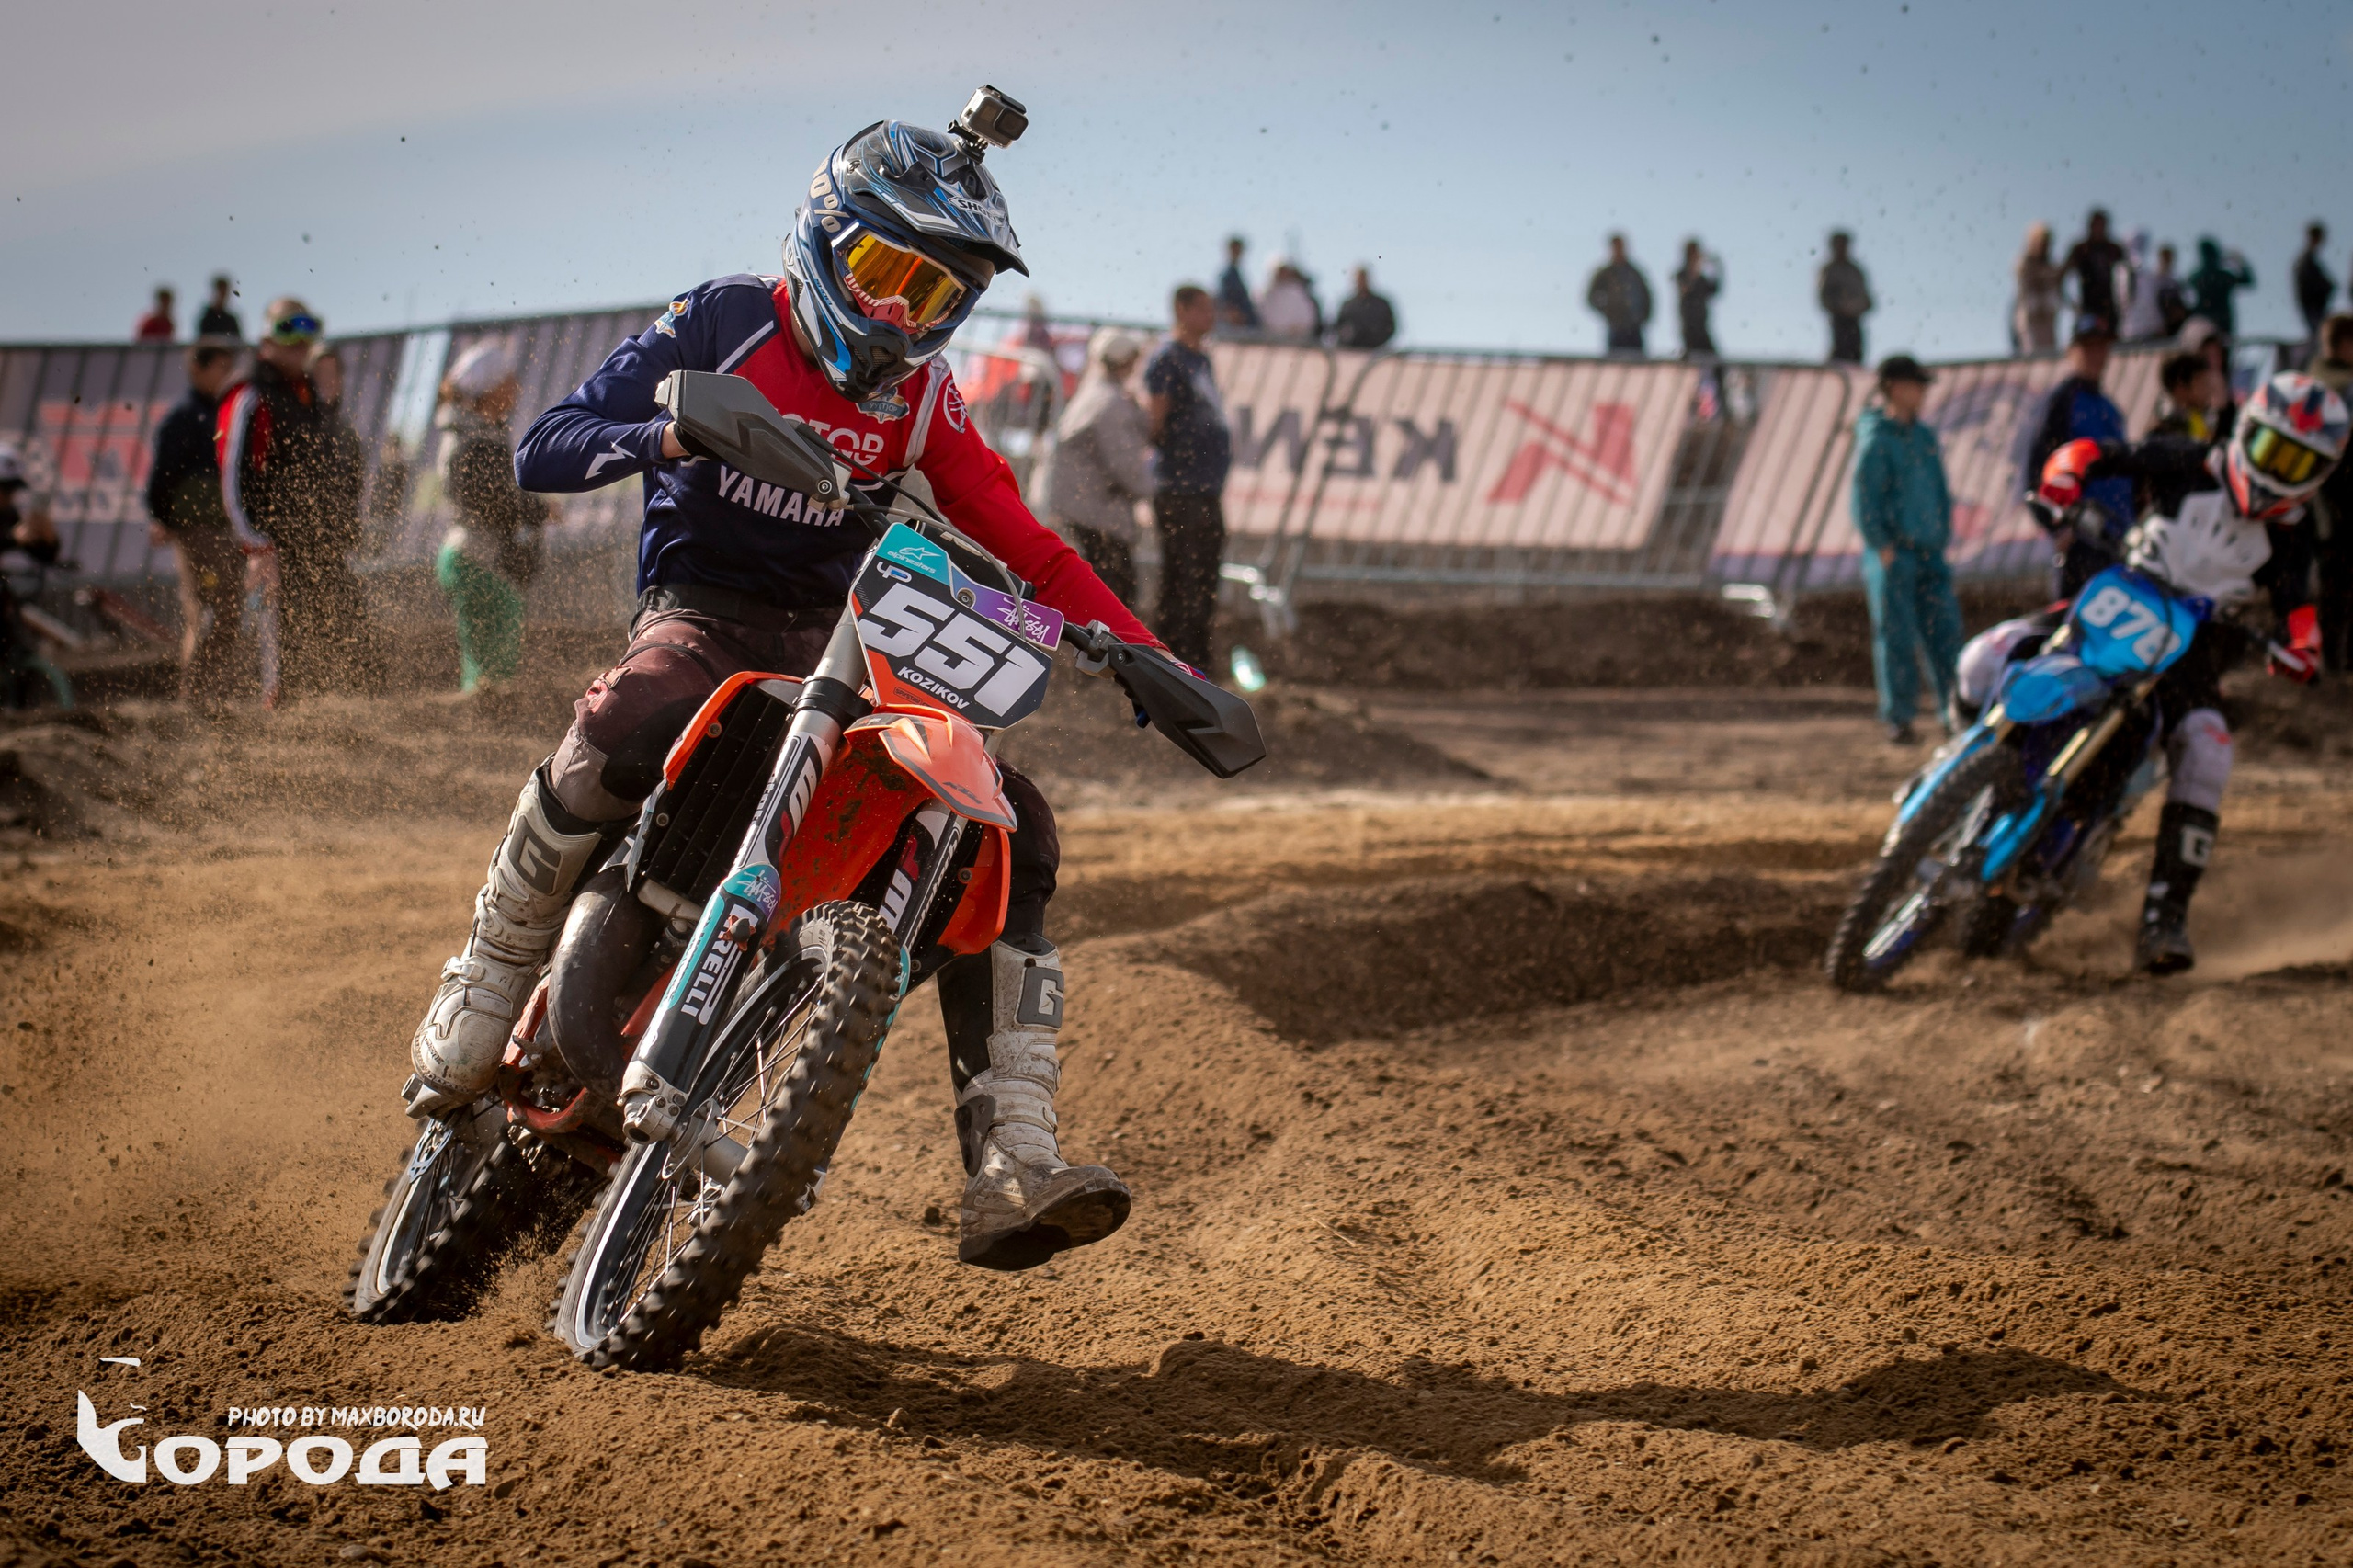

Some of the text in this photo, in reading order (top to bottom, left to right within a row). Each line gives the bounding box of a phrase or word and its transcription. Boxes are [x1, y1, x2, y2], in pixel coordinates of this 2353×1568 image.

[718, 464, 845, 527] YAMAHA
[887, 551, 936, 574] alpinestars
[858, 582, 1046, 717] 551
[897, 666, 970, 710] KOZIKOV
[681, 904, 759, 1025] PRELLI
